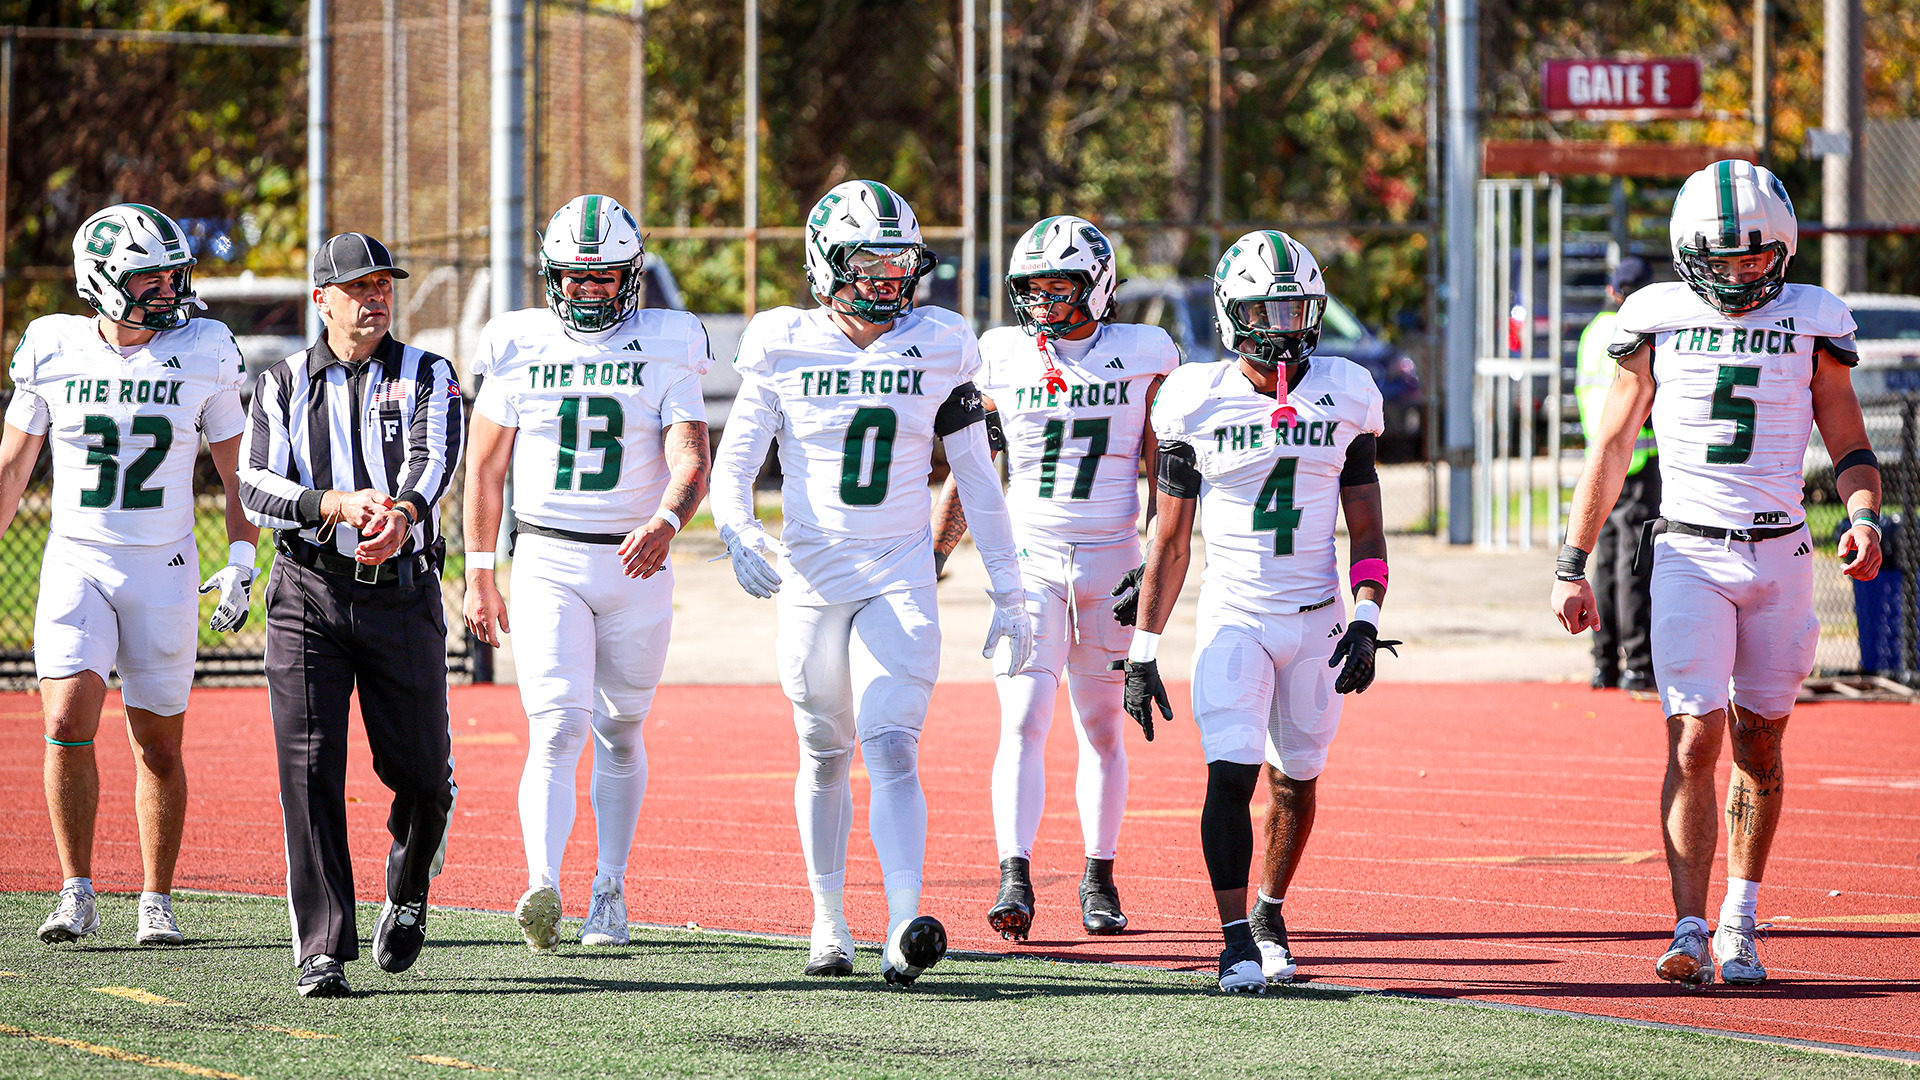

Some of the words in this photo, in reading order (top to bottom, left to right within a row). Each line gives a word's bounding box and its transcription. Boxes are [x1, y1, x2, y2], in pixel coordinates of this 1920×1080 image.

[1567, 64, 1645, 105] GATE
[1651, 64, 1671, 104] E
[85, 219, 125, 259] S
[882, 229, 902, 237] ROCK
[1020, 262, 1047, 270] Riddell
[1276, 284, 1298, 292] ROCK
[1674, 328, 1724, 351] THE
[1731, 327, 1797, 354] ROCK
[529, 363, 574, 389] THE
[582, 361, 648, 387] ROCK
[801, 370, 850, 396] THE
[860, 369, 926, 396] ROCK
[64, 379, 110, 404] THE
[118, 378, 185, 406] ROCK
[1016, 384, 1062, 410] THE
[1070, 379, 1138, 408] ROCK
[1706, 363, 1762, 464] 5
[383, 420, 399, 442] F
[553, 395, 625, 492] 13
[1214, 424, 1264, 454] THE
[1274, 420, 1342, 448] ROCK
[80, 414, 175, 511] 32
[839, 405, 898, 507] 0
[1038, 416, 1112, 501] 17
[1251, 456, 1305, 557] 4
